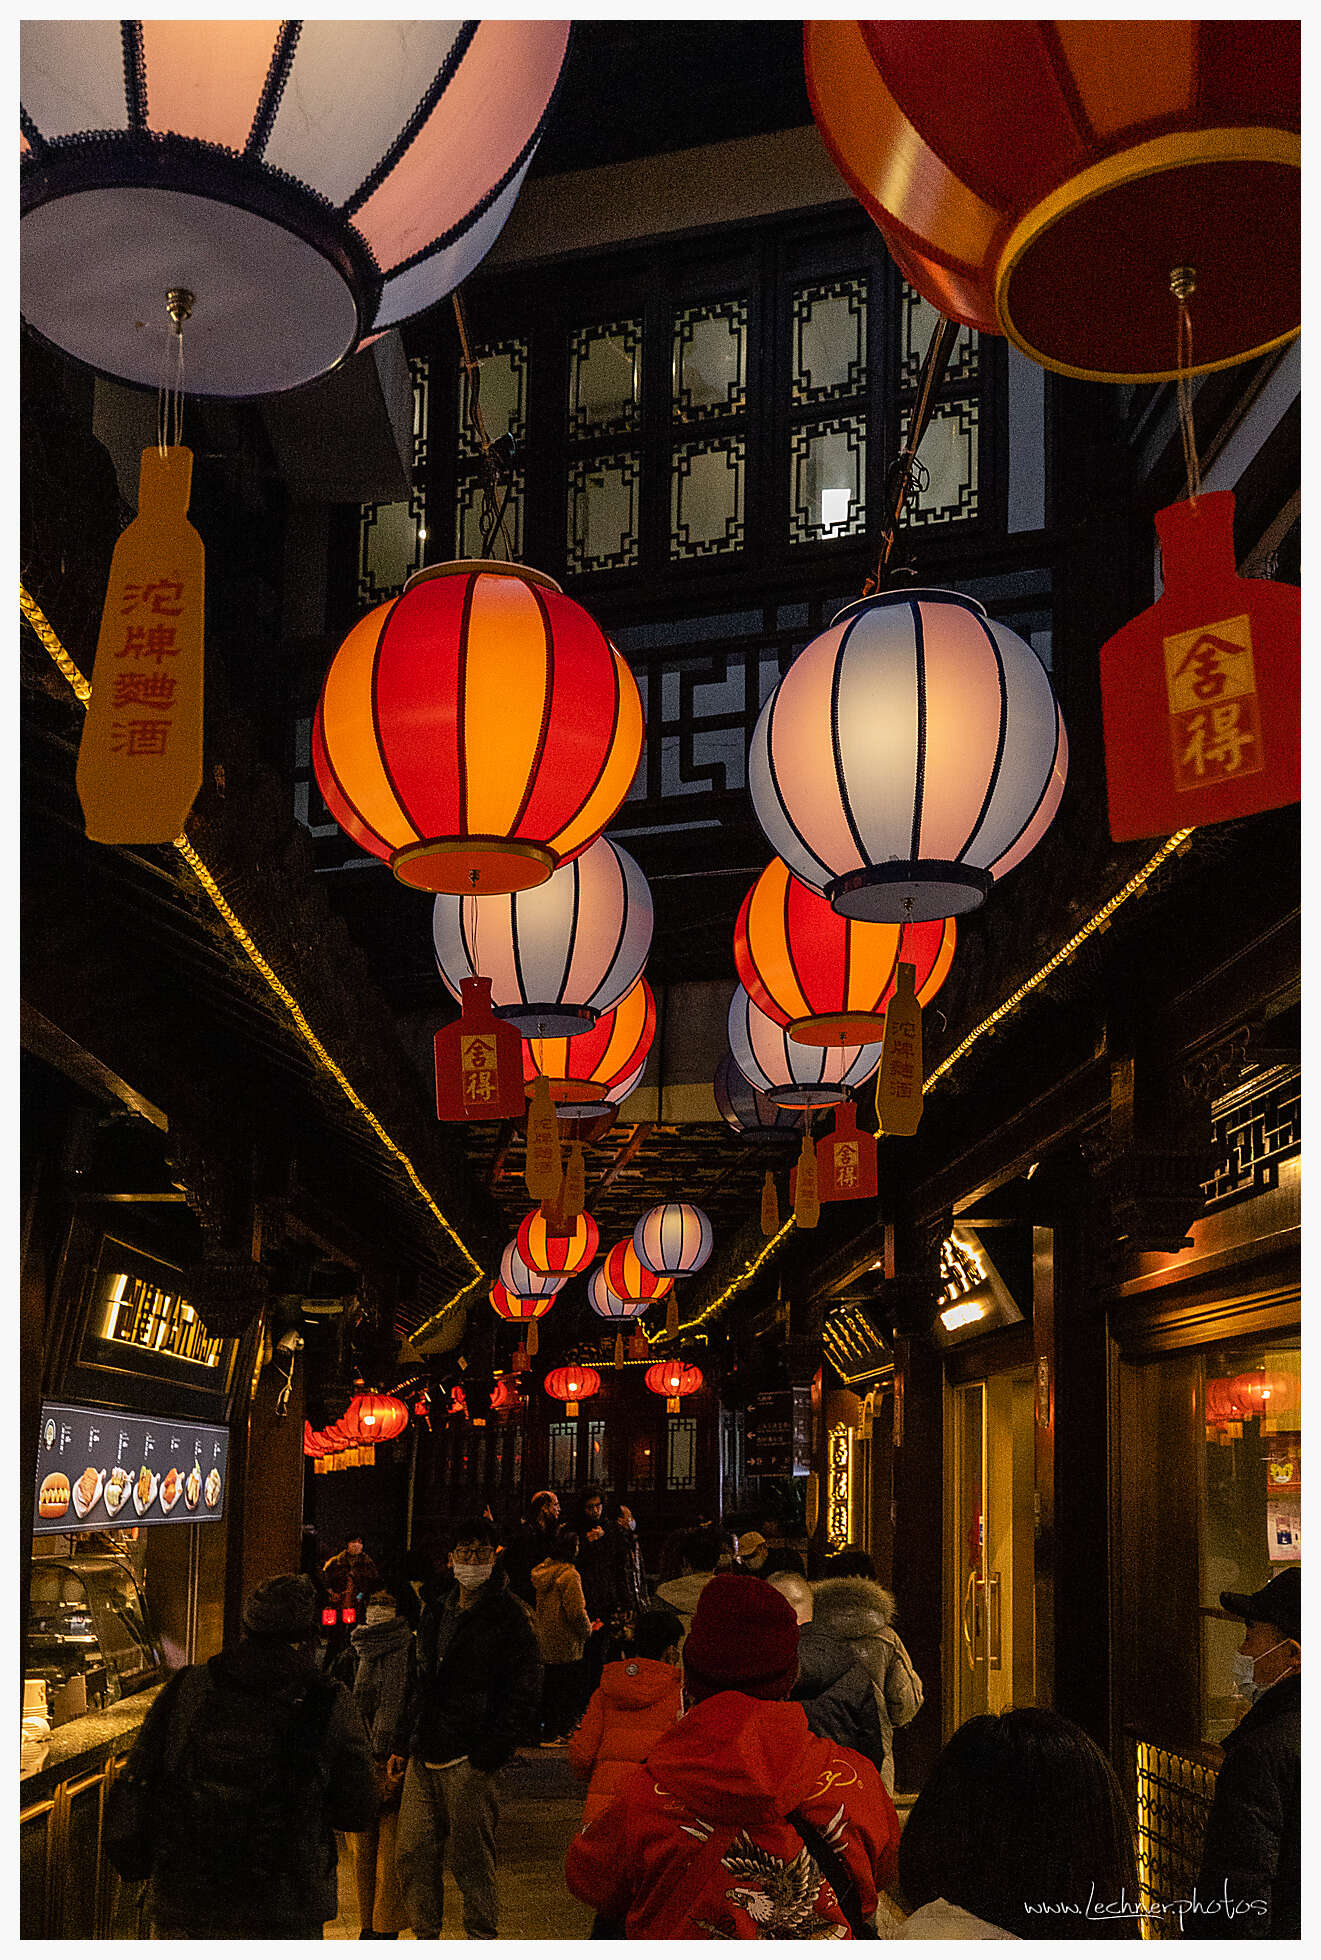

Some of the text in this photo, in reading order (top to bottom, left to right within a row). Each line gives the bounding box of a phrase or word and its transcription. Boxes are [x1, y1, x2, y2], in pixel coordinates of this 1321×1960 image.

[1175, 633, 1252, 774] 舍得
[465, 1038, 496, 1101] 舍得
[837, 1144, 857, 1188] 舍得
